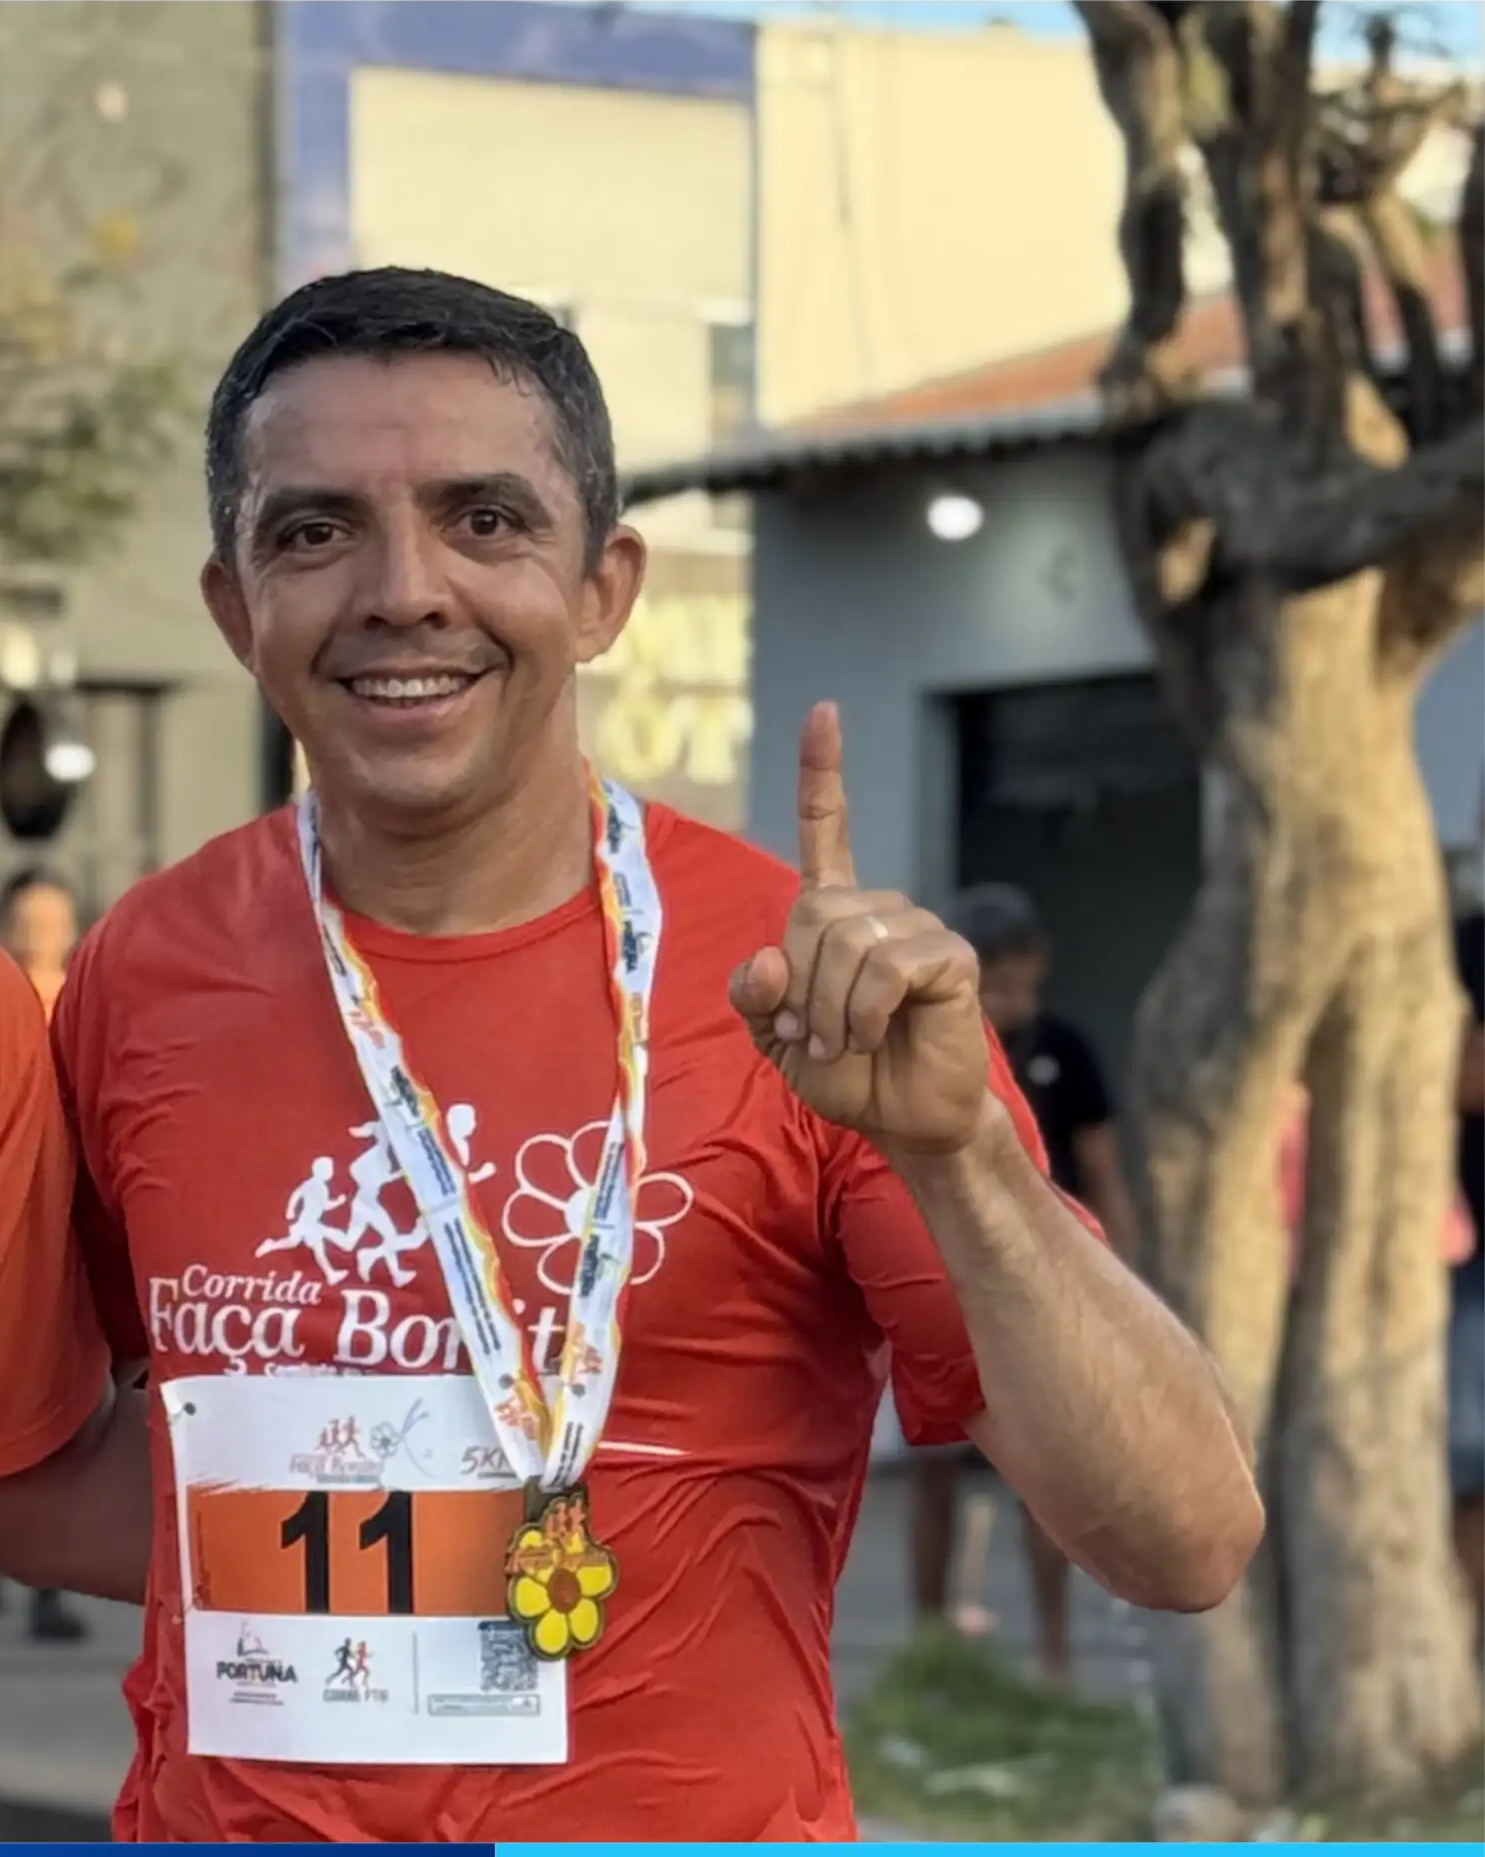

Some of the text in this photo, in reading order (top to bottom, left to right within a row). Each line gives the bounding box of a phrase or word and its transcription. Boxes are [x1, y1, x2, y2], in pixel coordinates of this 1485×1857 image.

[148, 1276, 306, 1377] Faça
[181, 1263, 322, 1306] Corrida
[280, 1490, 414, 1614] 11
